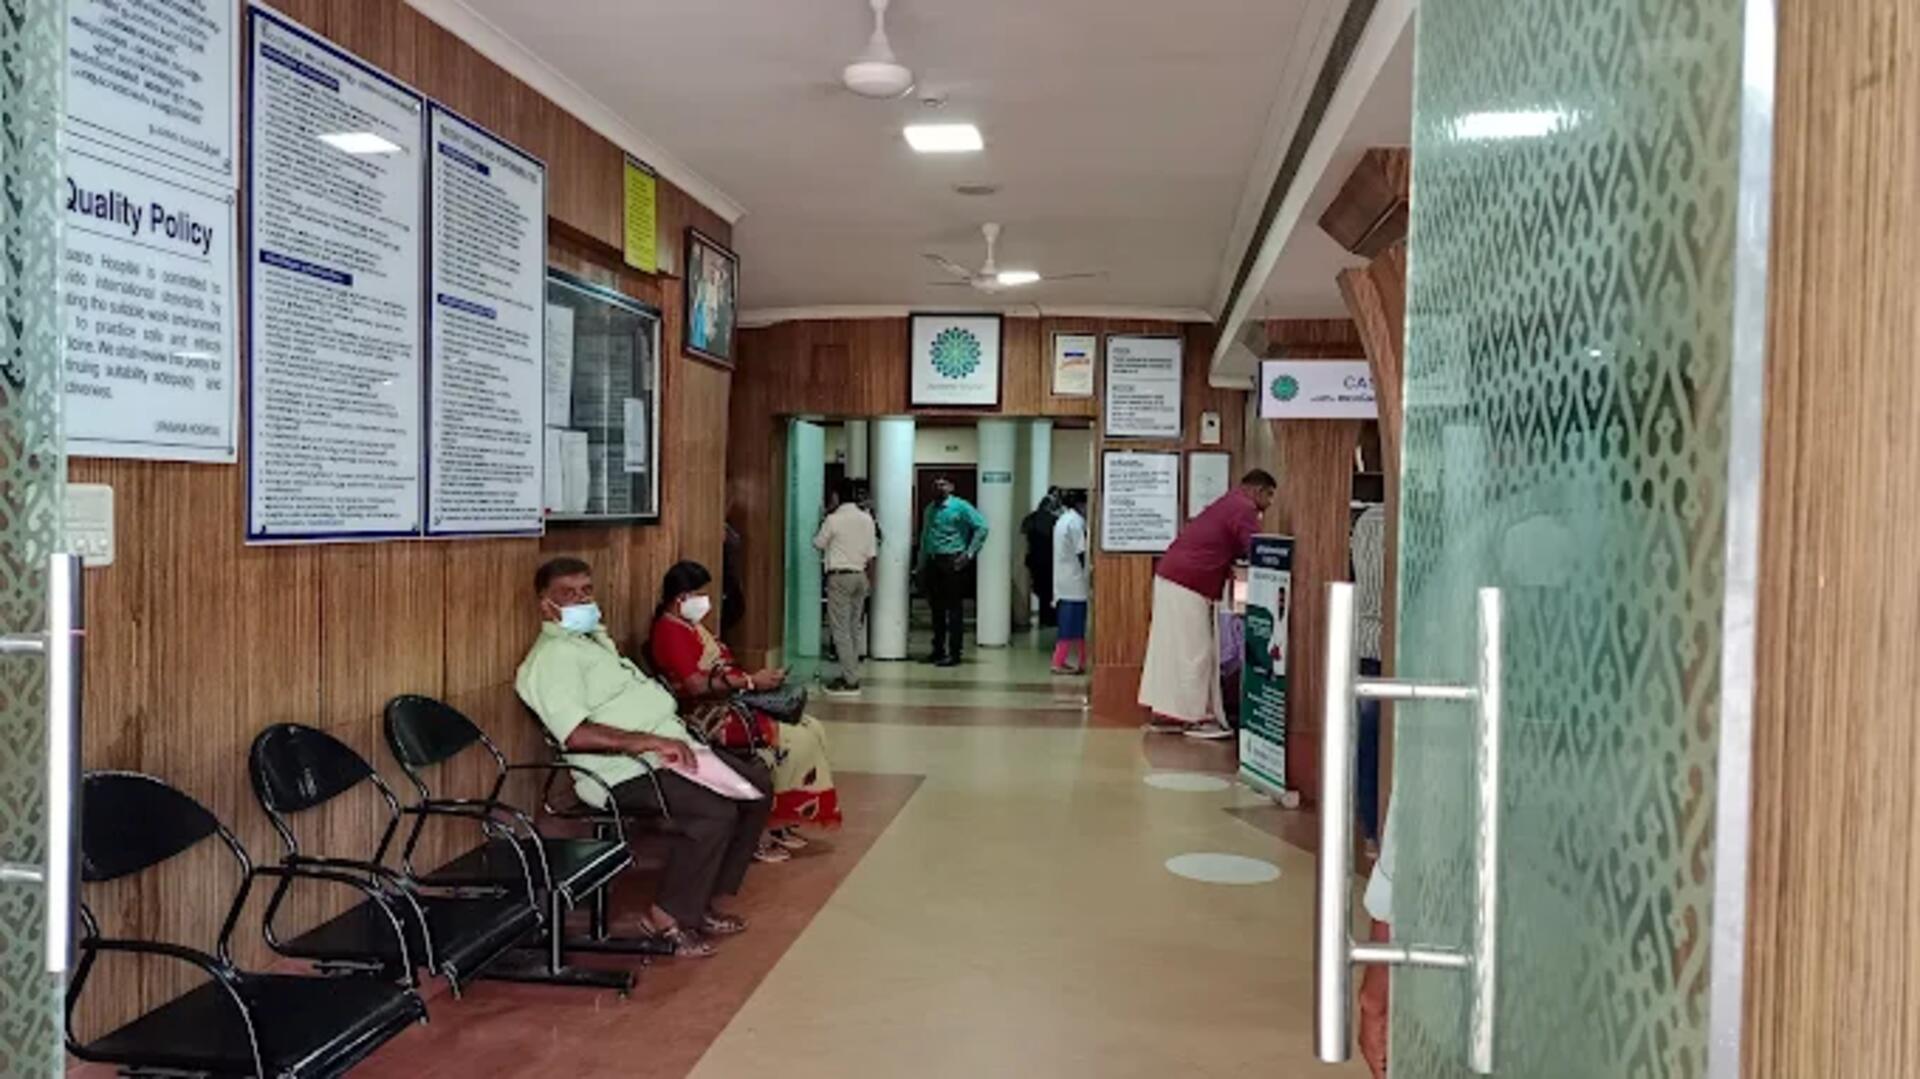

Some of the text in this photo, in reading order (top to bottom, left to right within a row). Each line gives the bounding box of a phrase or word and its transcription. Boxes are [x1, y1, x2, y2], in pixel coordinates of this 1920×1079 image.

[150, 202, 213, 255] Policy
[101, 254, 140, 276] Hospital
[162, 271, 207, 291] committed
[96, 275, 155, 300] international
[90, 295, 107, 311] the
[95, 320, 136, 339] practice
